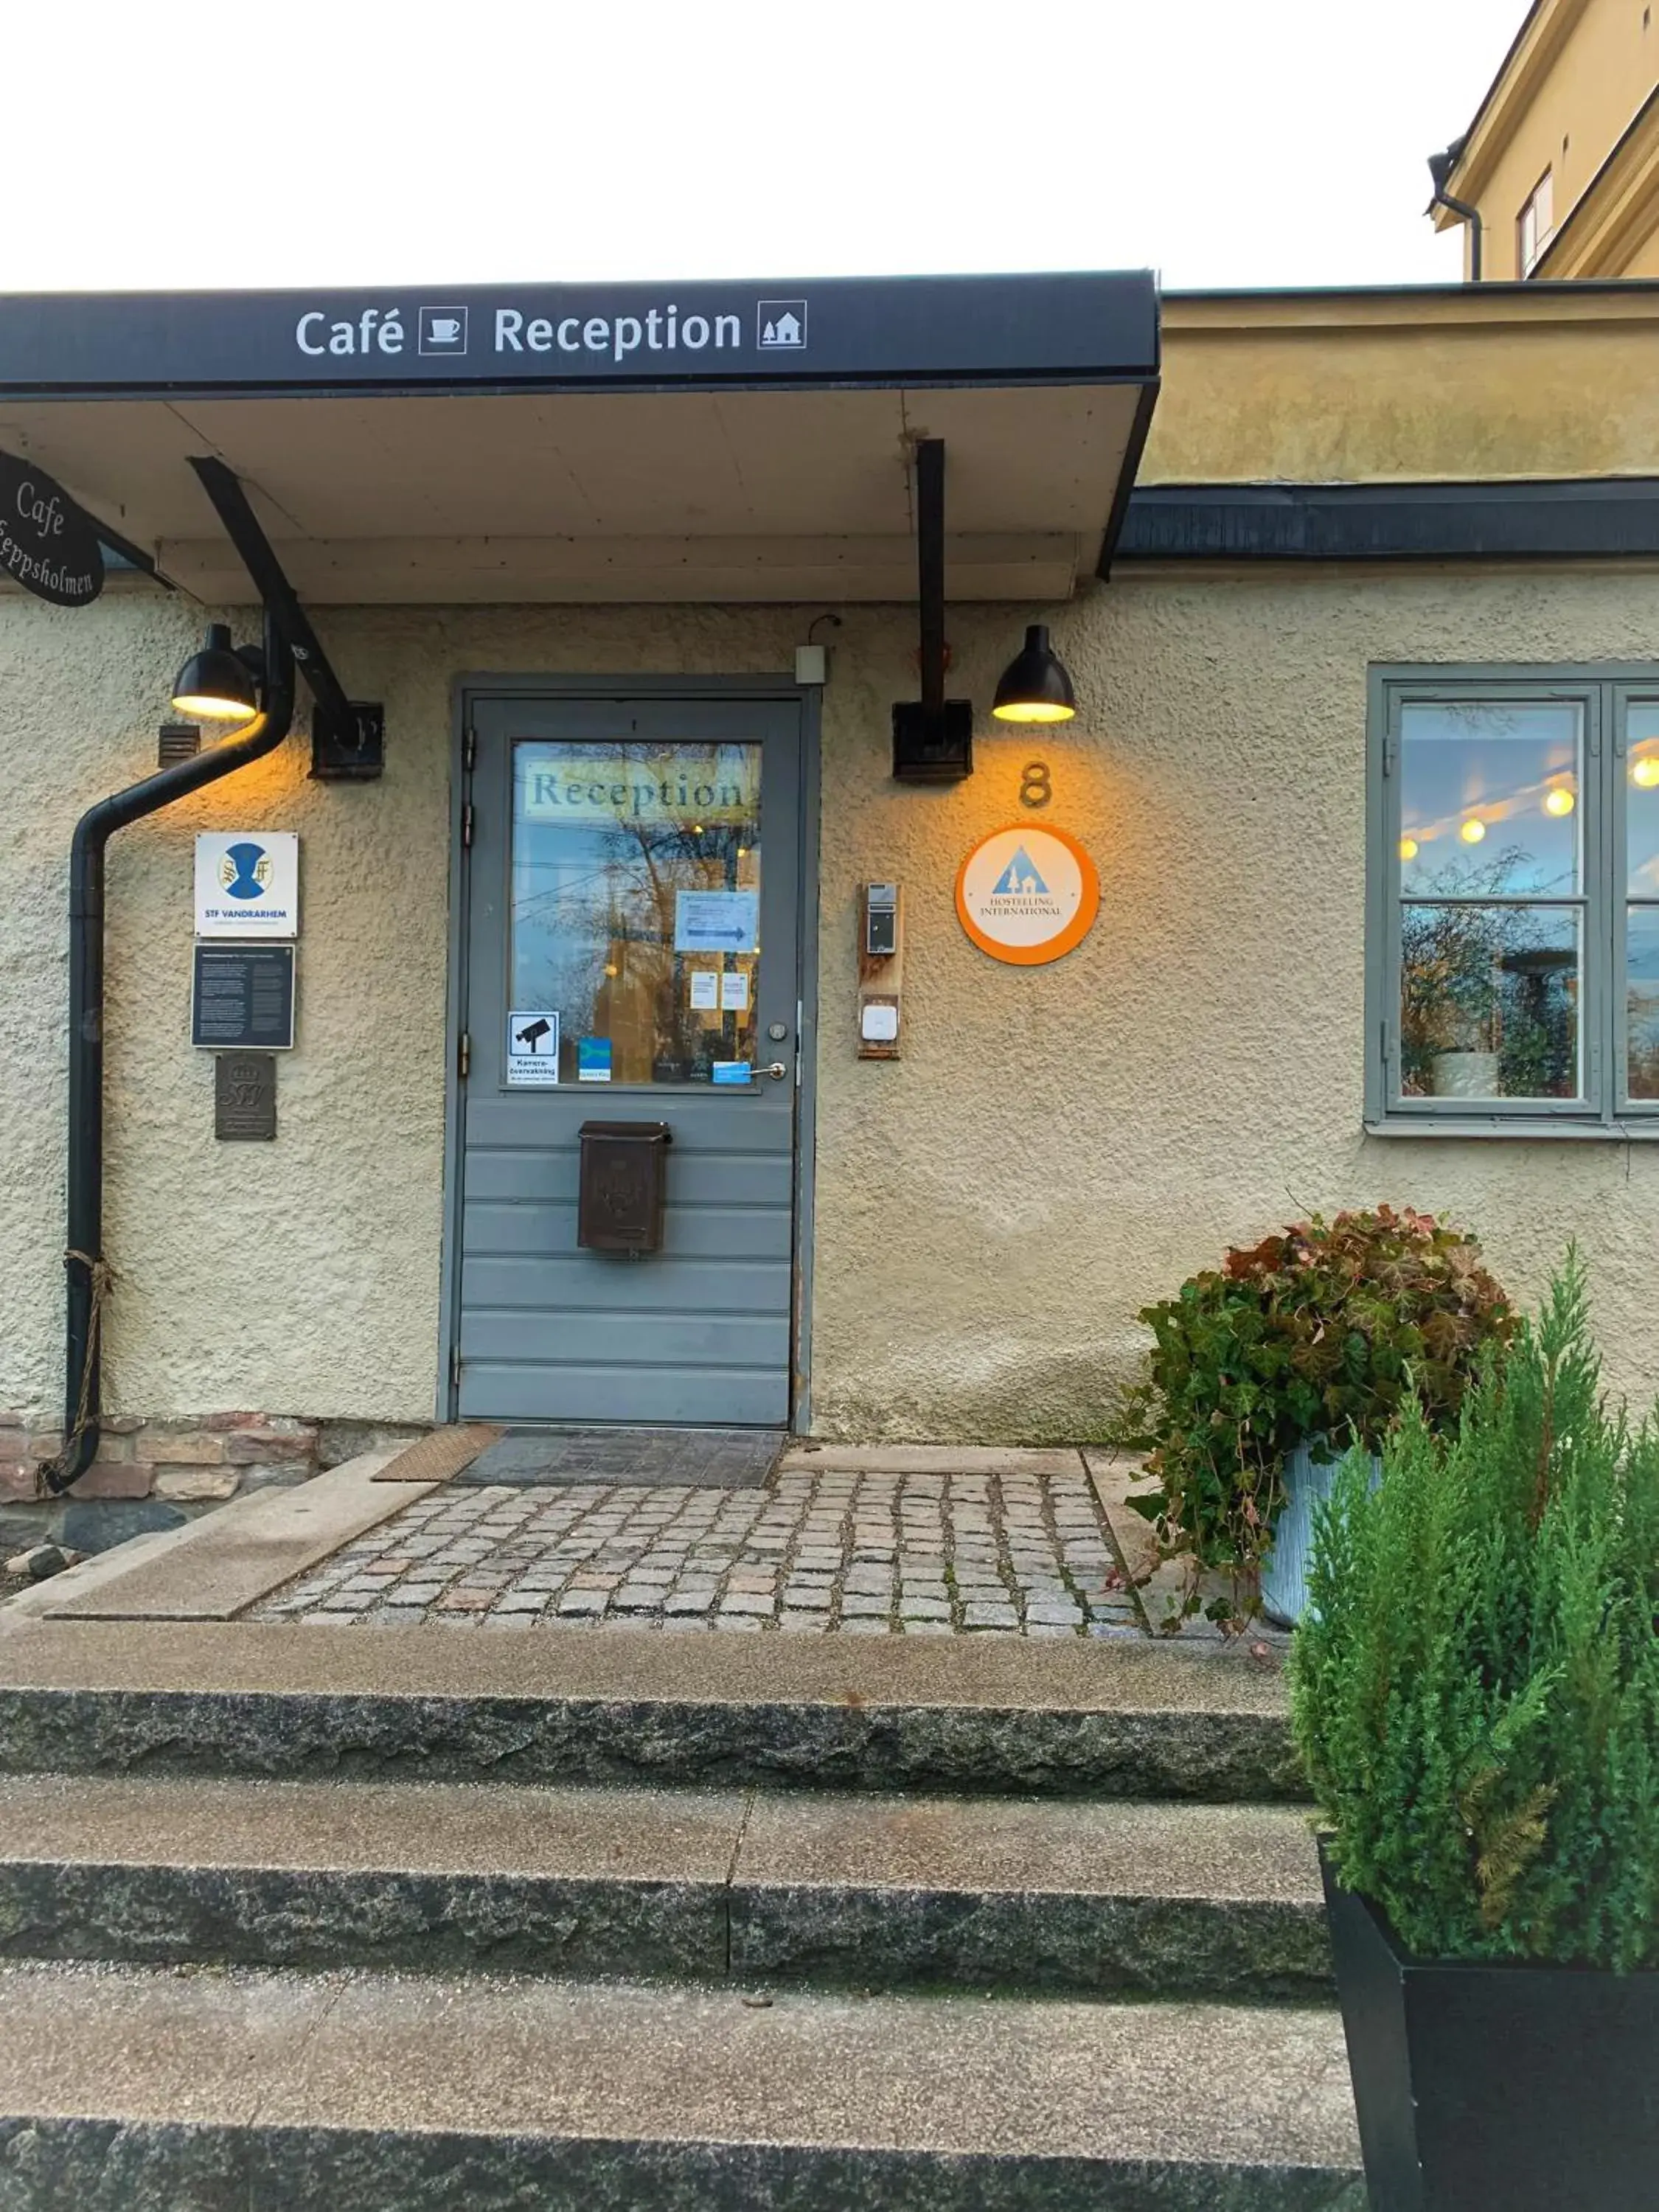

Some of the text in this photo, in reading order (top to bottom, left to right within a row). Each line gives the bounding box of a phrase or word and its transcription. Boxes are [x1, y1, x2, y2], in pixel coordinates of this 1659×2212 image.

[295, 304, 741, 362] Café Reception
[17, 481, 64, 537] Cafe
[531, 773, 744, 816] Reception
[1019, 759, 1052, 809] 8
[205, 909, 287, 918] STF VANDRARHEM
[981, 908, 1062, 916] INTERNATIONAL
[990, 897, 1054, 906] HOSTELLING
